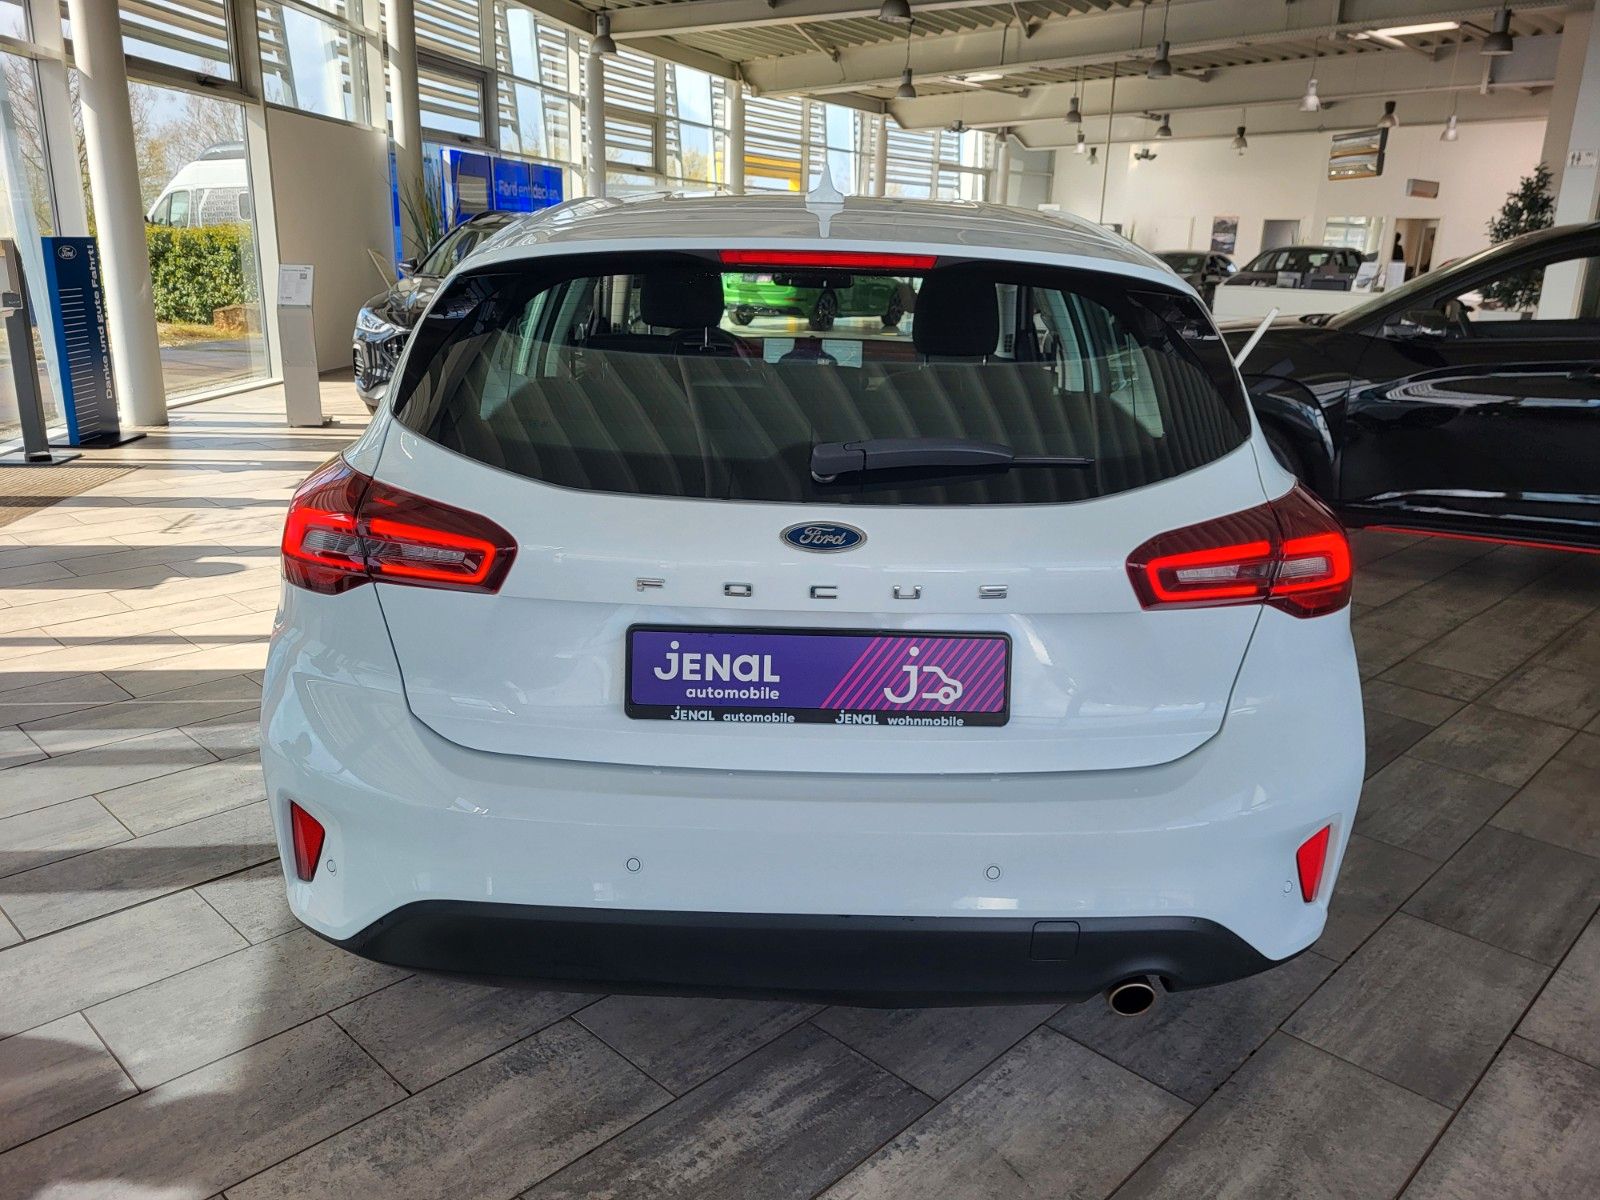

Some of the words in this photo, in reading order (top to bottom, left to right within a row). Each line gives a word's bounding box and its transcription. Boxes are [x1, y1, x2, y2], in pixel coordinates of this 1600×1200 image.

[87, 245, 99, 288] Fahrt!
[94, 290, 104, 324] gute
[97, 326, 107, 353] und
[102, 355, 113, 399] Danke
[799, 526, 847, 545] Ford
[636, 577, 1009, 600] FOCUS
[686, 686, 780, 700] automobile
[722, 711, 795, 723] automobile
[887, 715, 964, 727] wohnmobile
